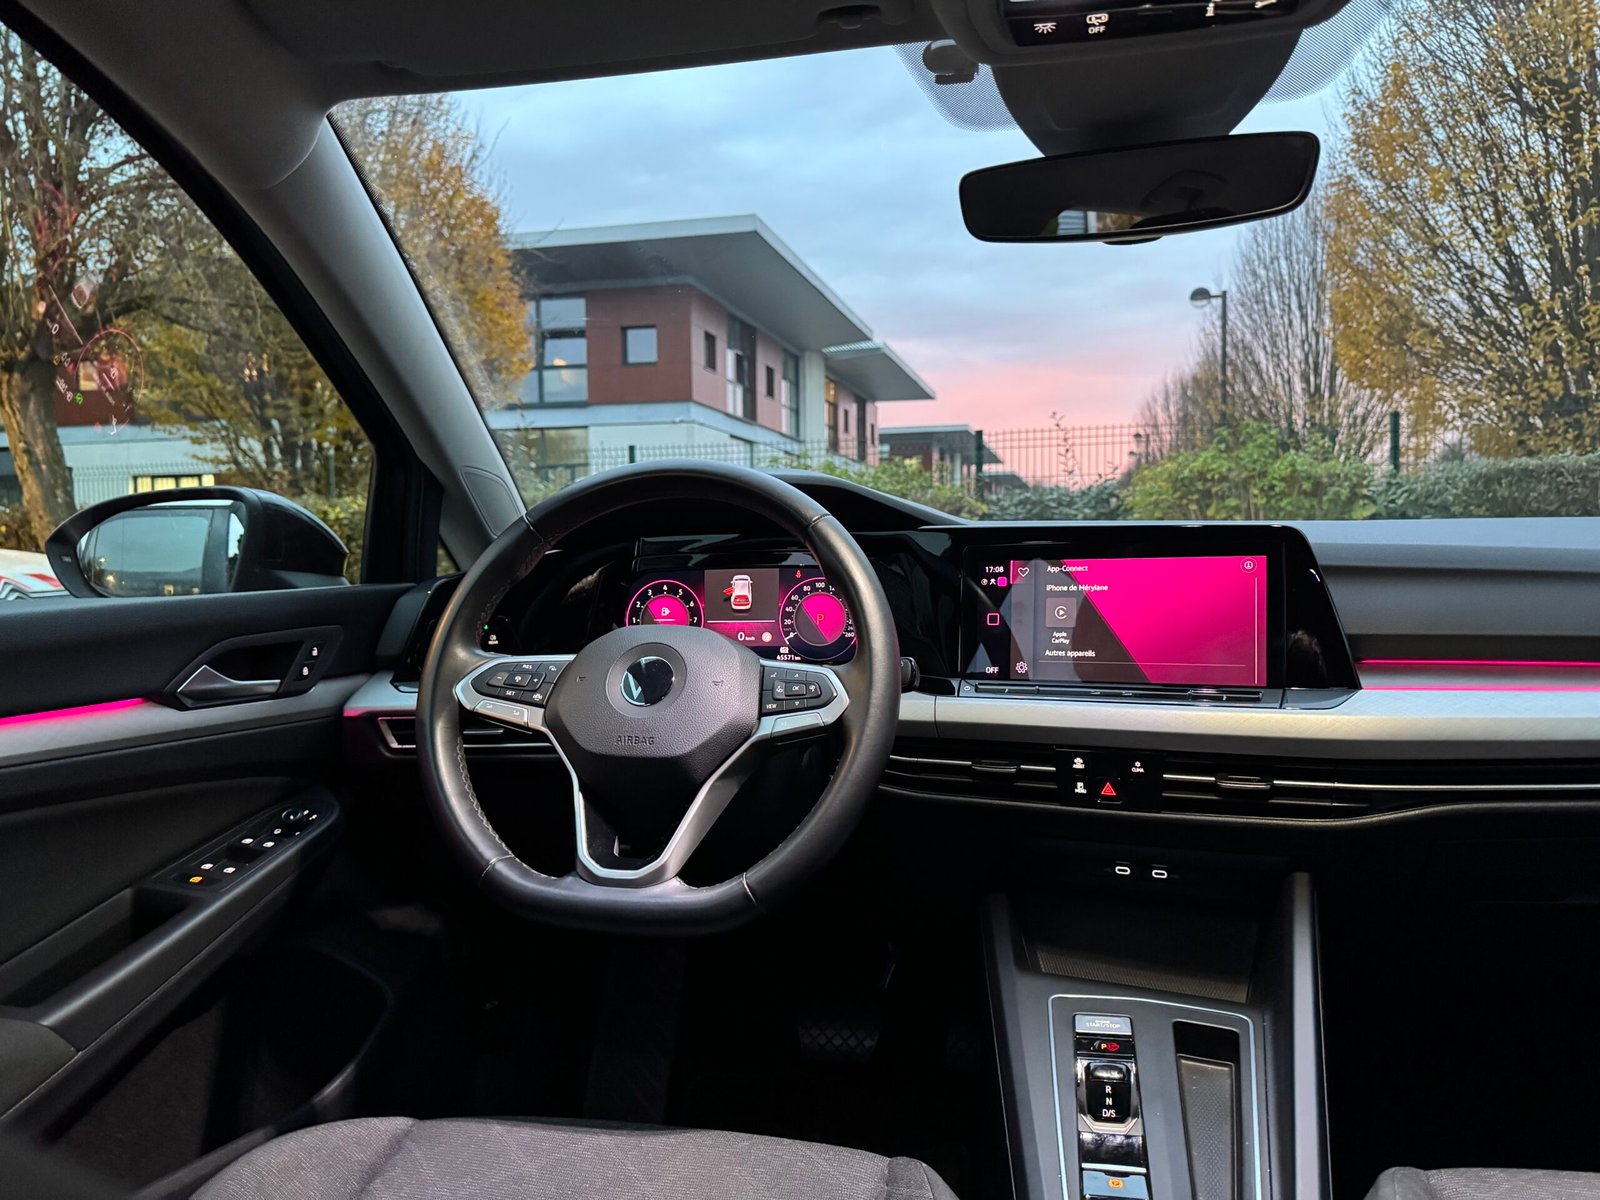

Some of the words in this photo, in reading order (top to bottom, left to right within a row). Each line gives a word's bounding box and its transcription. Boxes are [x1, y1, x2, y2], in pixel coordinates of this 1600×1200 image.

[1088, 25, 1106, 34] OFF
[1046, 565, 1088, 573] App-Connect
[1078, 584, 1109, 592] Mérylane
[816, 613, 825, 625] P
[738, 631, 745, 641] 0
[1051, 637, 1070, 645] CarPlay
[1045, 649, 1066, 657] Autres
[1066, 650, 1096, 658] appareils
[616, 735, 655, 746] AIRBAG
[1105, 1085, 1112, 1094] R
[1105, 1097, 1113, 1106] N
[1102, 1108, 1116, 1118] D/S
